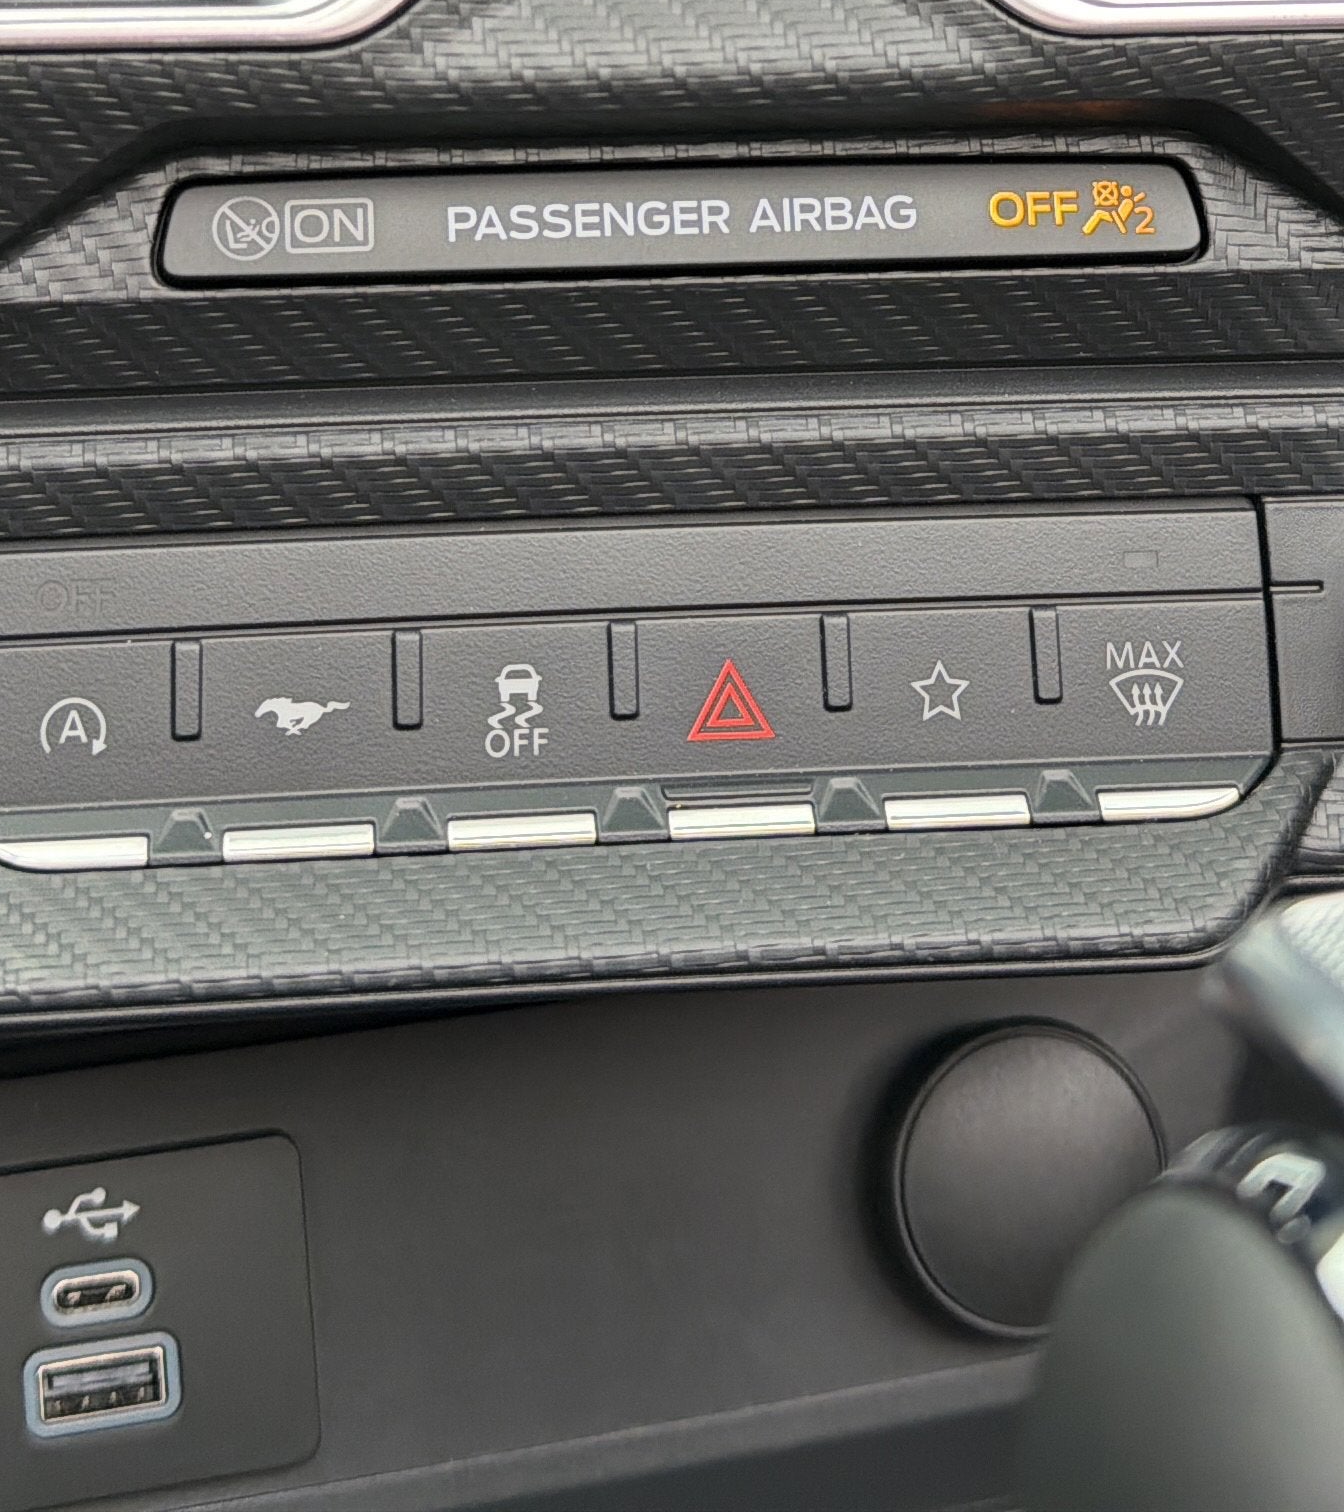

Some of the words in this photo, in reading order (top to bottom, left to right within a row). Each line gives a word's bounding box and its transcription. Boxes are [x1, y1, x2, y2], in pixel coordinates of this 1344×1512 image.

[294, 207, 365, 243] ON
[446, 201, 732, 242] PASSENGER
[749, 194, 918, 234] AIRBAG
[989, 191, 1078, 228] OFF
[1106, 640, 1183, 670] MAX
[484, 728, 549, 759] OFF
